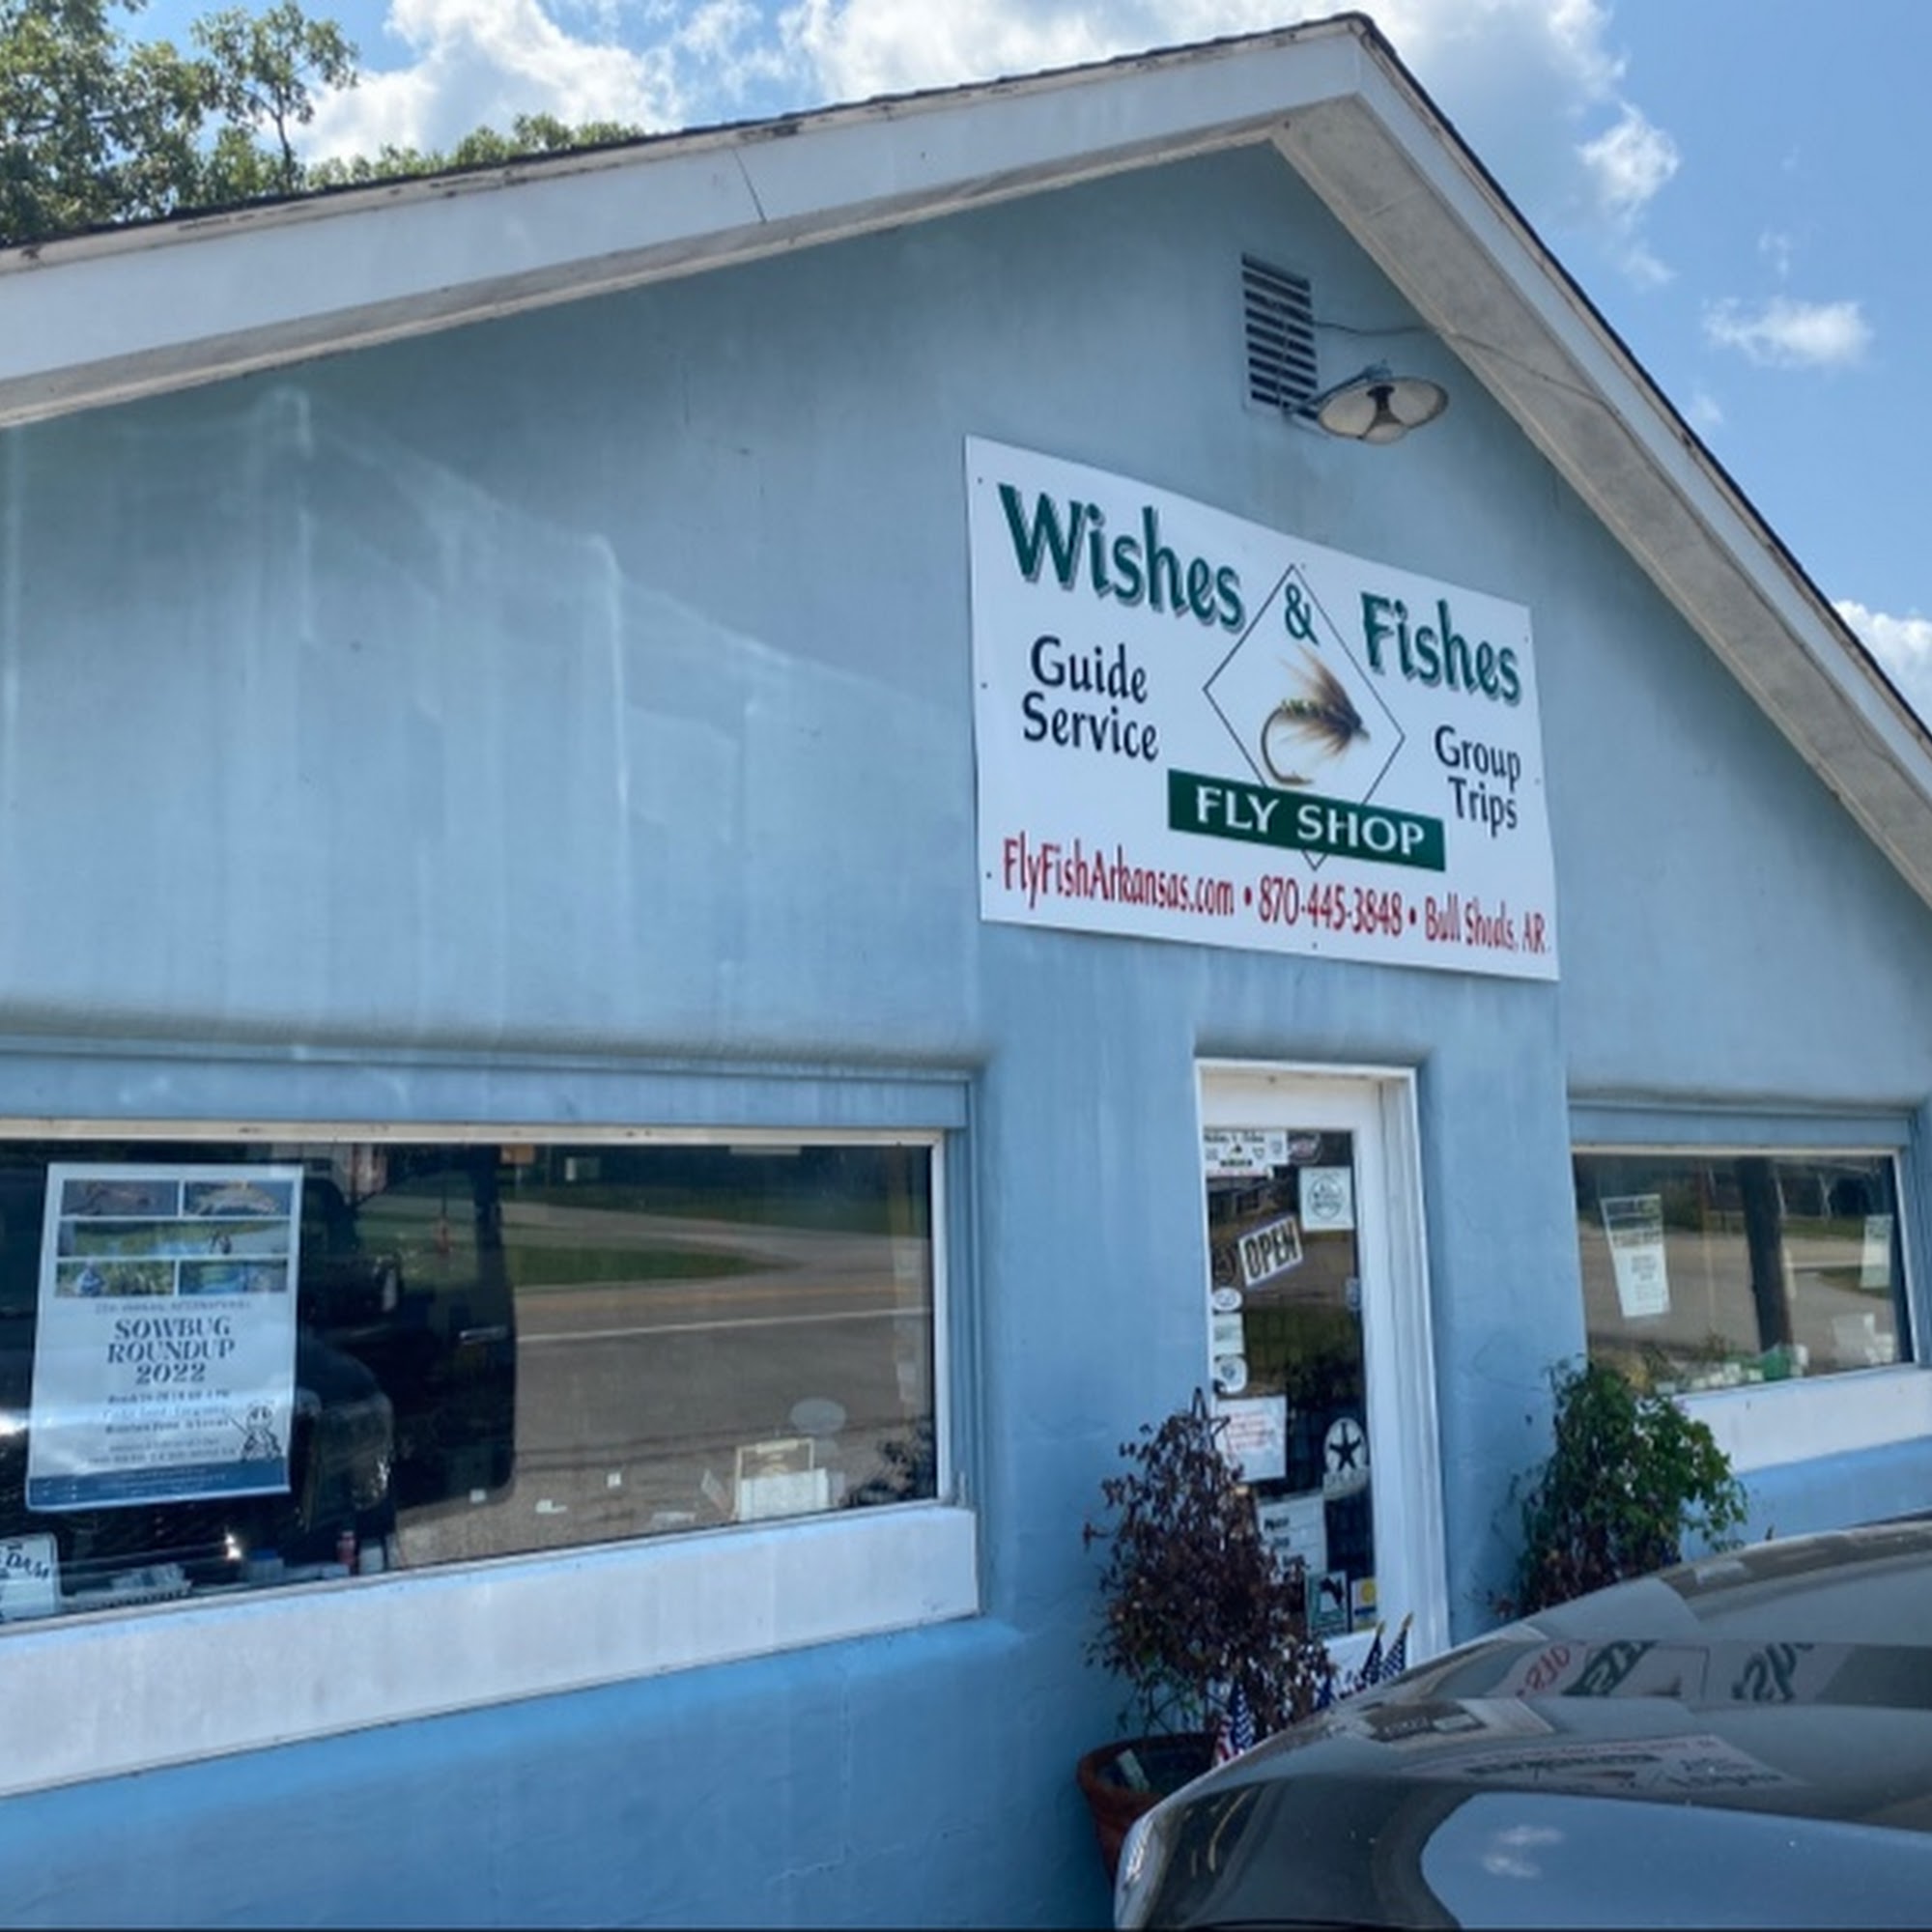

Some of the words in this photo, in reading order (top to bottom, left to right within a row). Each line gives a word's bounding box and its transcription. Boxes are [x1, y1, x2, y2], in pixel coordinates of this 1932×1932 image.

[998, 482, 1246, 635] Wishes
[1285, 582, 1320, 648] &
[1360, 590, 1522, 707] Fishes
[1030, 635, 1149, 705] Guide
[1022, 691, 1159, 762] Service
[1434, 724, 1521, 793] Group
[1196, 785, 1280, 834] FLY
[1296, 805, 1426, 856] SHOP
[1447, 776, 1519, 838] Trips
[1004, 830, 1235, 916] FlyFishArkansas.com
[1258, 874, 1403, 936] 870-445-3848
[1243, 1220, 1299, 1280] OPEN
[107, 1338, 236, 1364] ROUNDUP
[114, 1315, 232, 1341] SOWBUG
[135, 1362, 207, 1386] 2022
